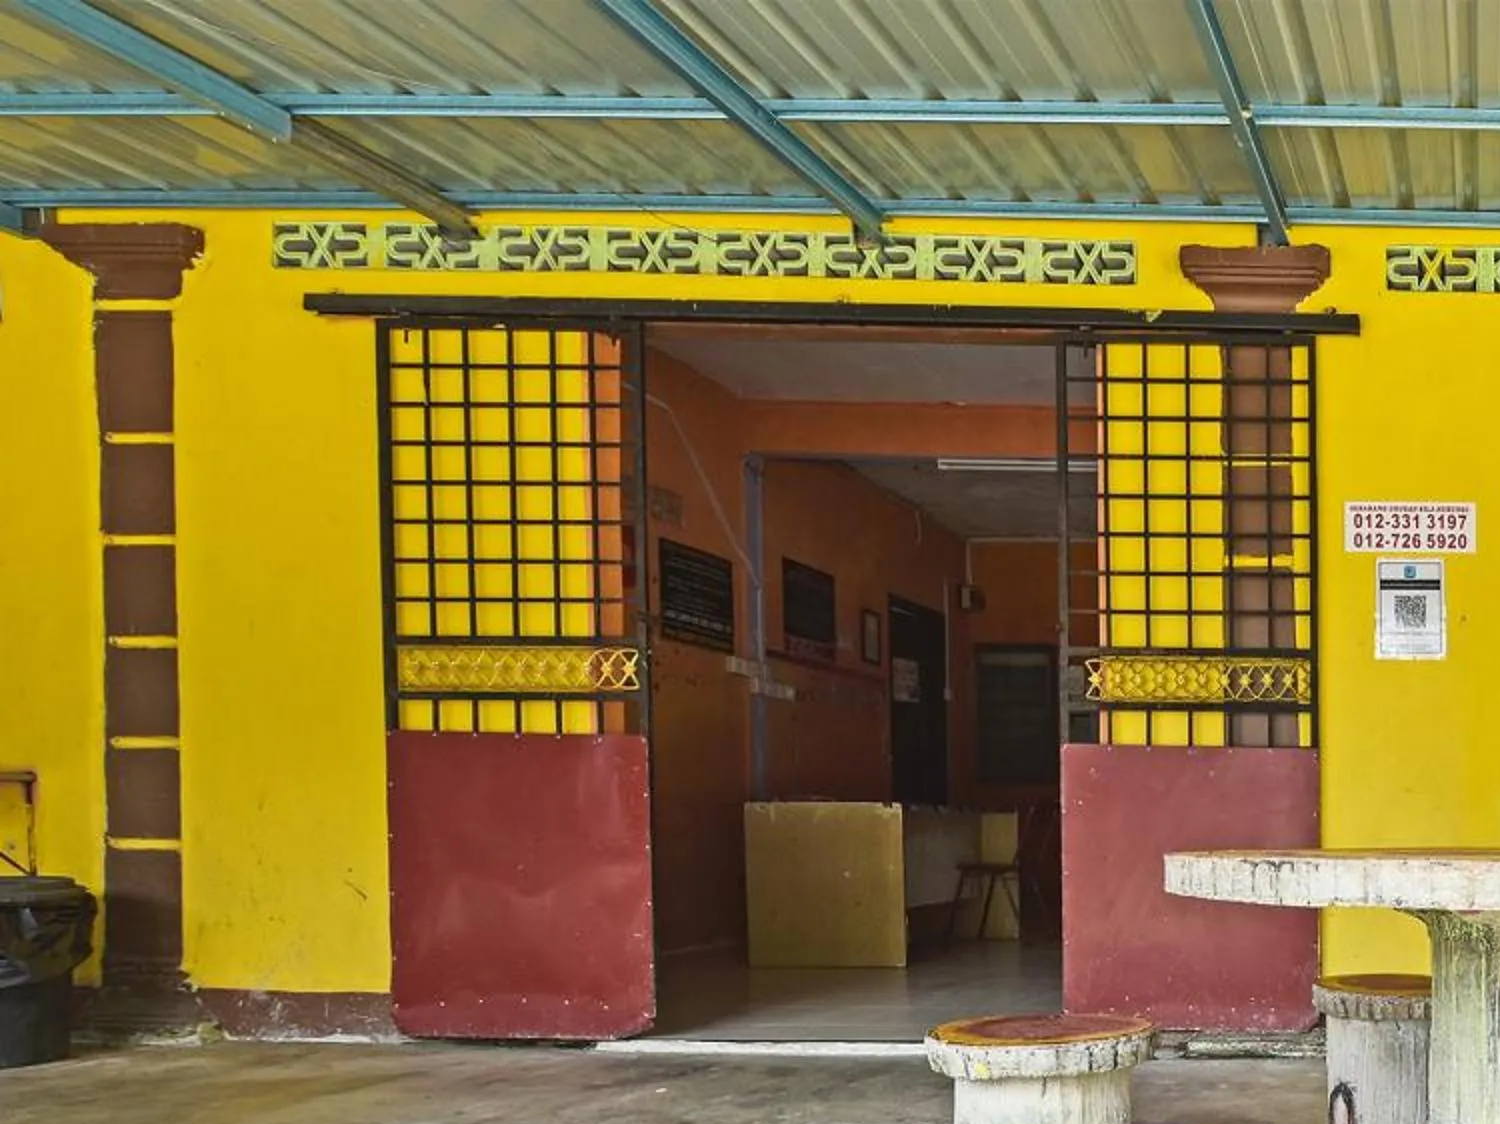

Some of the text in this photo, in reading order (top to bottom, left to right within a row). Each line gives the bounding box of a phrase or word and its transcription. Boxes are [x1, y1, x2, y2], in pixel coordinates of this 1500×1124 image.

[1353, 513, 1467, 530] 012-331 3197
[1353, 533, 1467, 549] 012-726 5920
